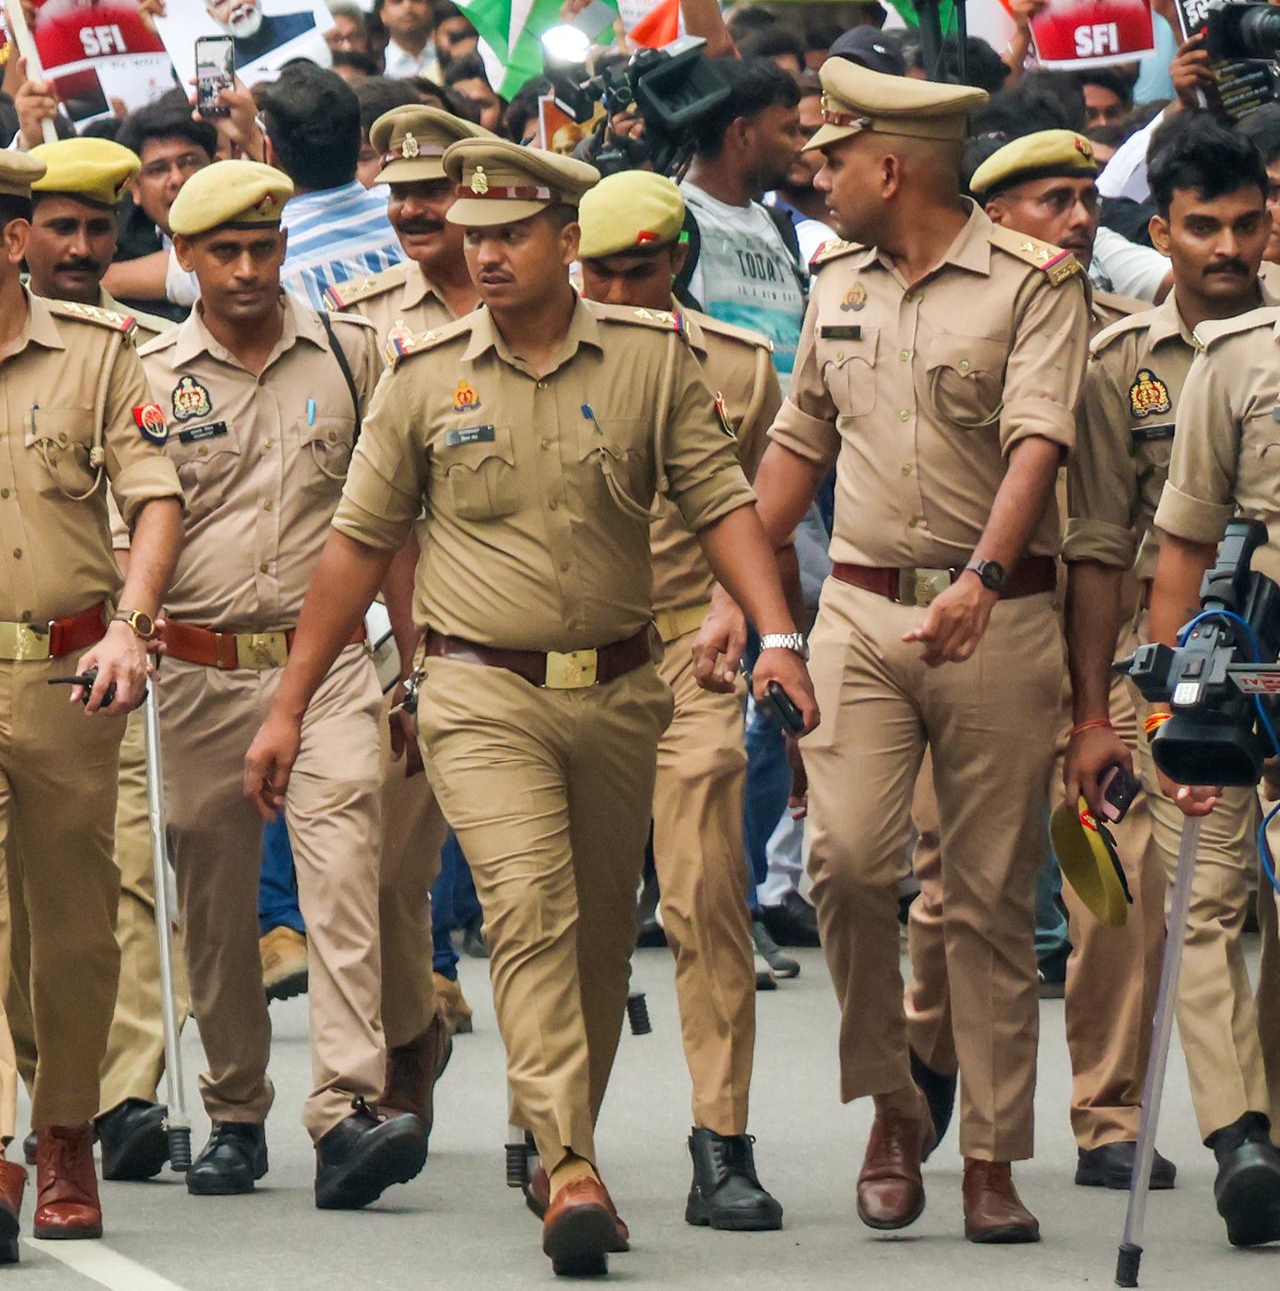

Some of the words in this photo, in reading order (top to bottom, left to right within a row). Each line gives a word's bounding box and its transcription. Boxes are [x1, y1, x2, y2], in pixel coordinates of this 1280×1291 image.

[79, 24, 127, 58] SFI
[1074, 22, 1120, 58] SFI
[736, 249, 786, 284] TODAY
